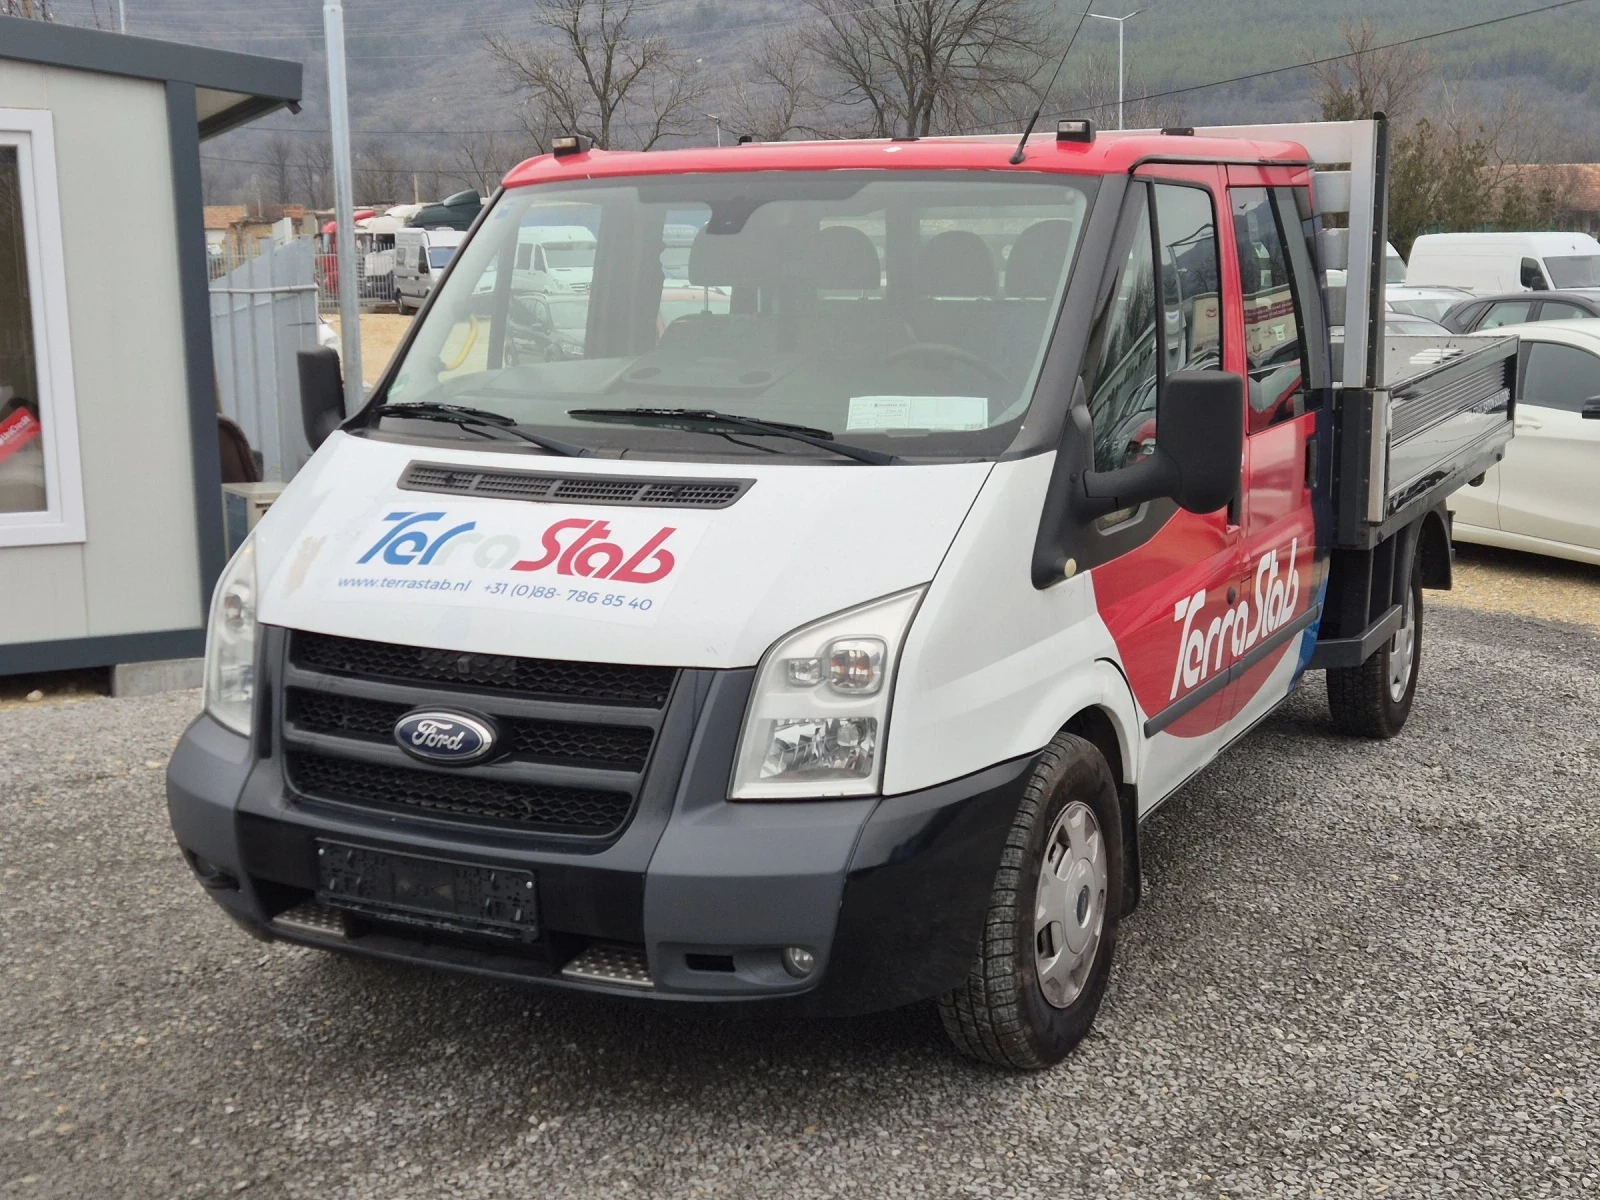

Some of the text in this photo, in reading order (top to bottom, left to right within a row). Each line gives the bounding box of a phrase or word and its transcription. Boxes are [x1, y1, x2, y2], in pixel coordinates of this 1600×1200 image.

[337, 577, 472, 592] www.terrastab.nl
[484, 583, 508, 596] +31
[566, 589, 598, 605] 786
[601, 593, 624, 608] 85
[628, 597, 653, 612] 40
[411, 719, 465, 751] Ford
